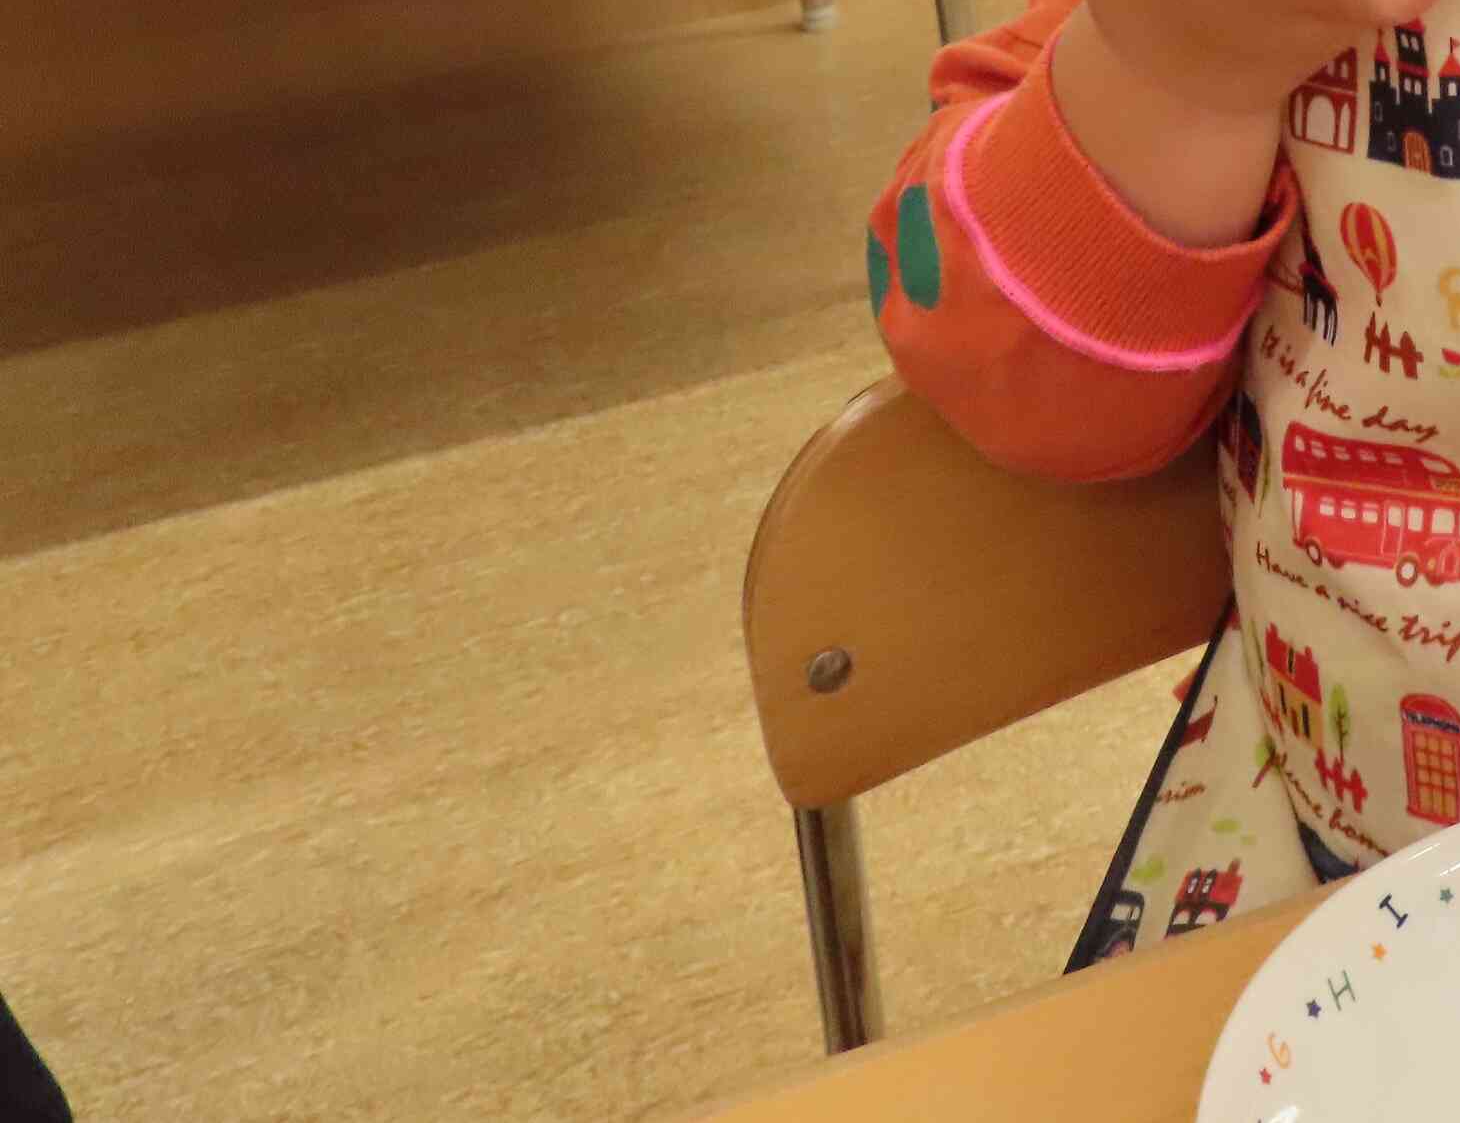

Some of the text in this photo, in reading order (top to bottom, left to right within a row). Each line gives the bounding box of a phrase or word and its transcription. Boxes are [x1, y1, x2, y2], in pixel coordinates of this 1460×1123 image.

[1305, 368, 1351, 420] fine
[1362, 405, 1439, 443] day
[1255, 540, 1309, 588] Have
[1315, 584, 1331, 600] a
[1336, 598, 1388, 633] nice
[1327, 969, 1356, 1011] H
[1379, 893, 1408, 929] I
